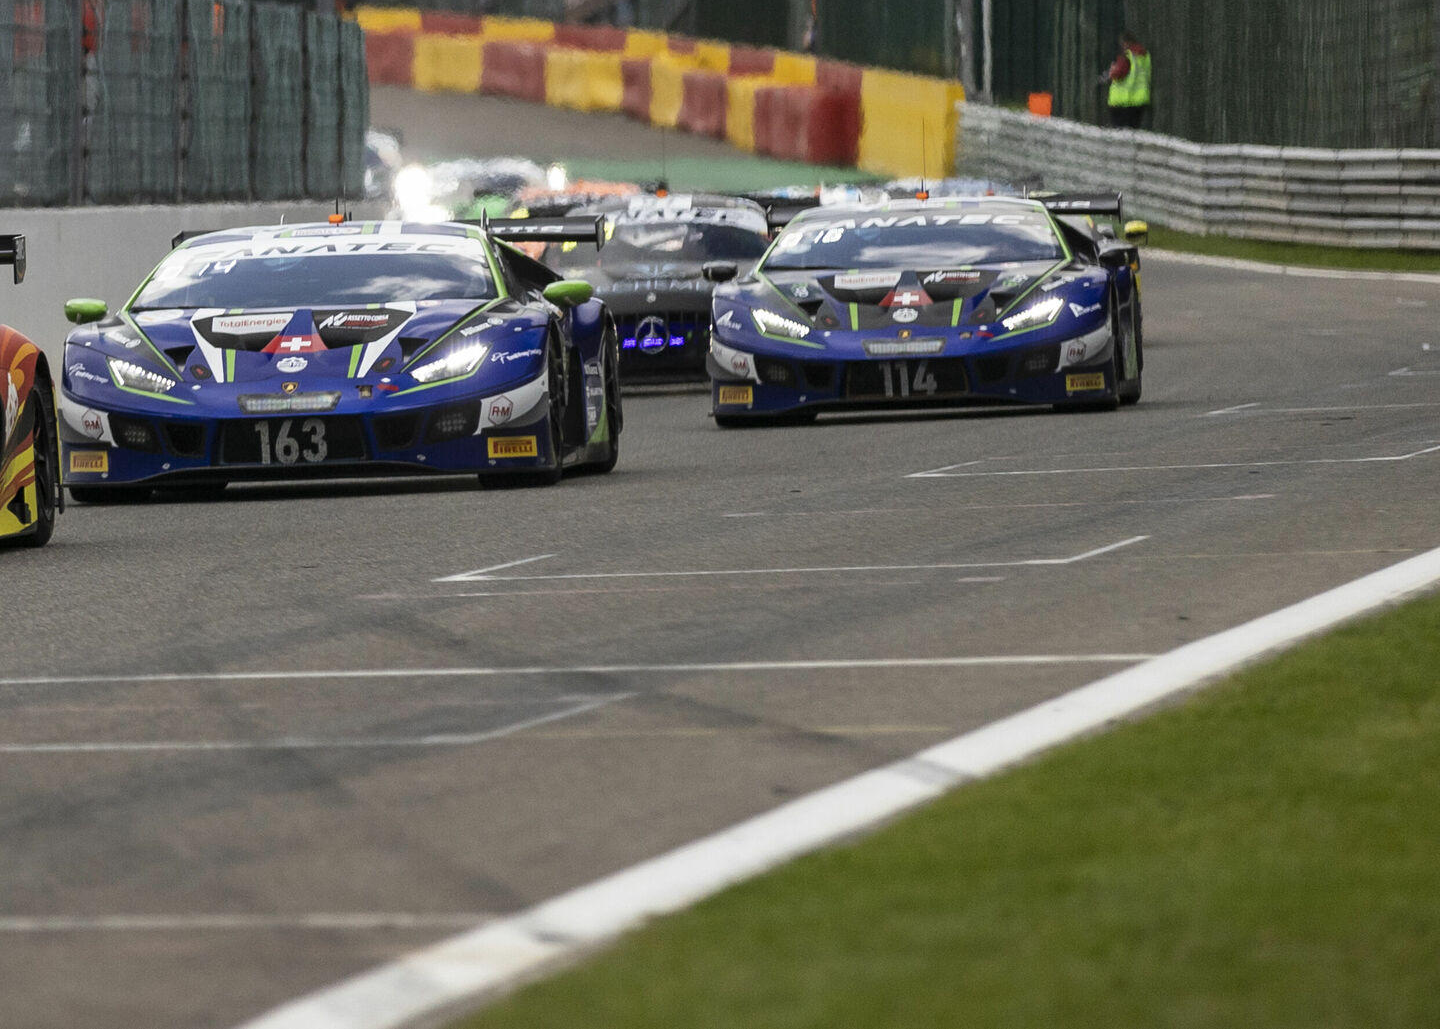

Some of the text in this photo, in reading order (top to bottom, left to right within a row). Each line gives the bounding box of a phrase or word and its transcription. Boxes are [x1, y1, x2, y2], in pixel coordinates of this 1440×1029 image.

[798, 214, 1025, 236] FANATEC
[184, 242, 455, 266] FANATEC
[220, 317, 287, 328] TotalEnergies
[878, 361, 938, 398] 114
[254, 418, 328, 465] 163
[493, 439, 533, 455] PIRELLI
